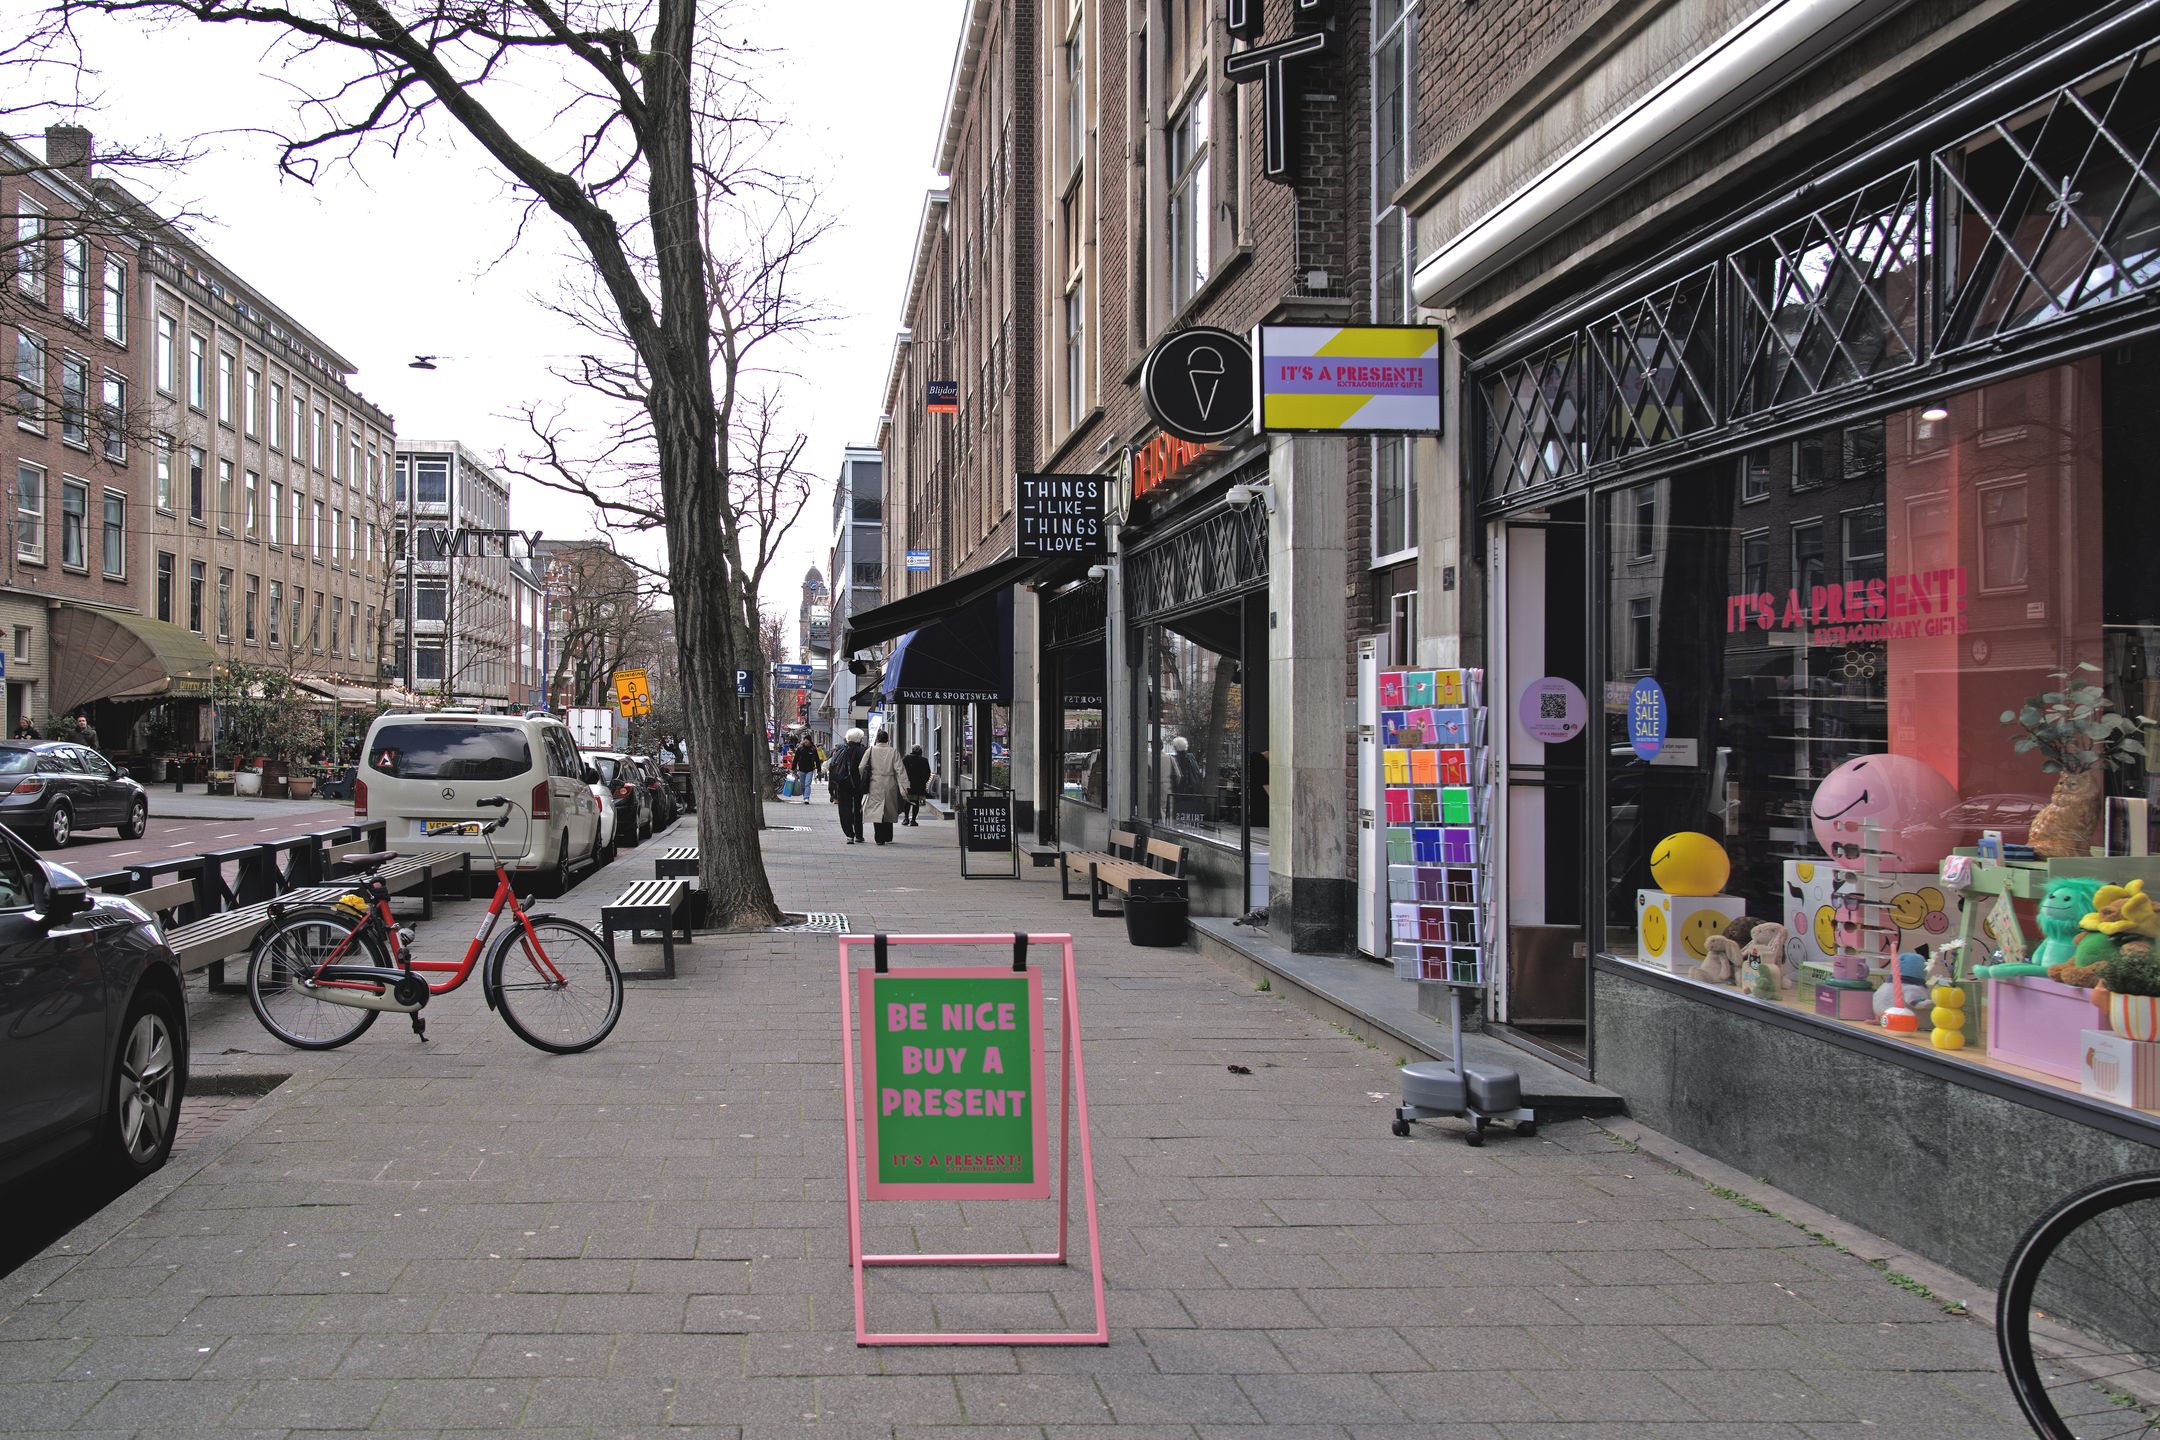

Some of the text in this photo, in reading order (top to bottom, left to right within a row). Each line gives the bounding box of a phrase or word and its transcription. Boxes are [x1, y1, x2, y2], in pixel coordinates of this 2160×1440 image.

[1280, 365, 1424, 382] IT'S A PRESENT!
[1023, 481, 1098, 498] THINGS
[1048, 500, 1082, 515] LIKE
[1024, 517, 1097, 535] THINGS
[1046, 537, 1083, 552] LOVE
[1727, 568, 1968, 634] IT'S A PRESENT!
[1814, 615, 1968, 646] EXTRAORDINARY GIFTS
[736, 670, 747, 684] P
[903, 690, 998, 700] DANCE & SPORTSWEAR
[1635, 690, 1659, 705] SALE
[1635, 706, 1659, 720] SALE
[1635, 721, 1659, 736] SALE
[972, 808, 1006, 816] THINGS
[973, 824, 1006, 832] THINGS
[888, 1002, 1016, 1032] BE NICE
[902, 1046, 1004, 1074] BUY A
[882, 1088, 1026, 1117] PRESENT
[892, 1154, 1022, 1167] IT'S A PRESENT!
